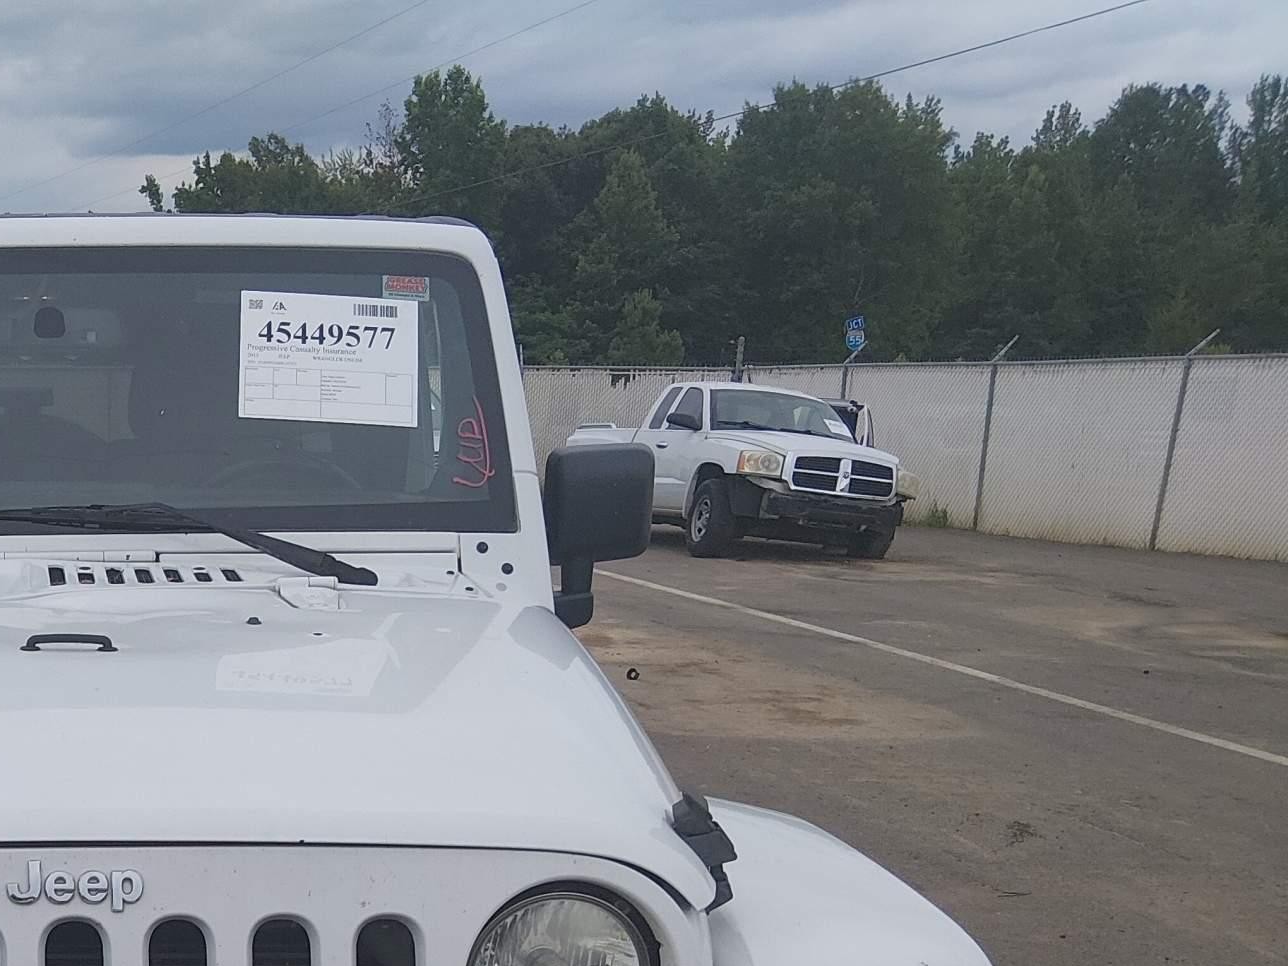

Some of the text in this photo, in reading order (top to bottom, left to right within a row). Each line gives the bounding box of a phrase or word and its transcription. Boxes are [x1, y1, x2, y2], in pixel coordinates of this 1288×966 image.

[848, 319, 862, 330] JCT
[258, 320, 396, 350] 45449577
[849, 336, 861, 345] 55
[247, 343, 357, 356] Progressive Casualty Insurance
[6, 859, 144, 913] Jeep
